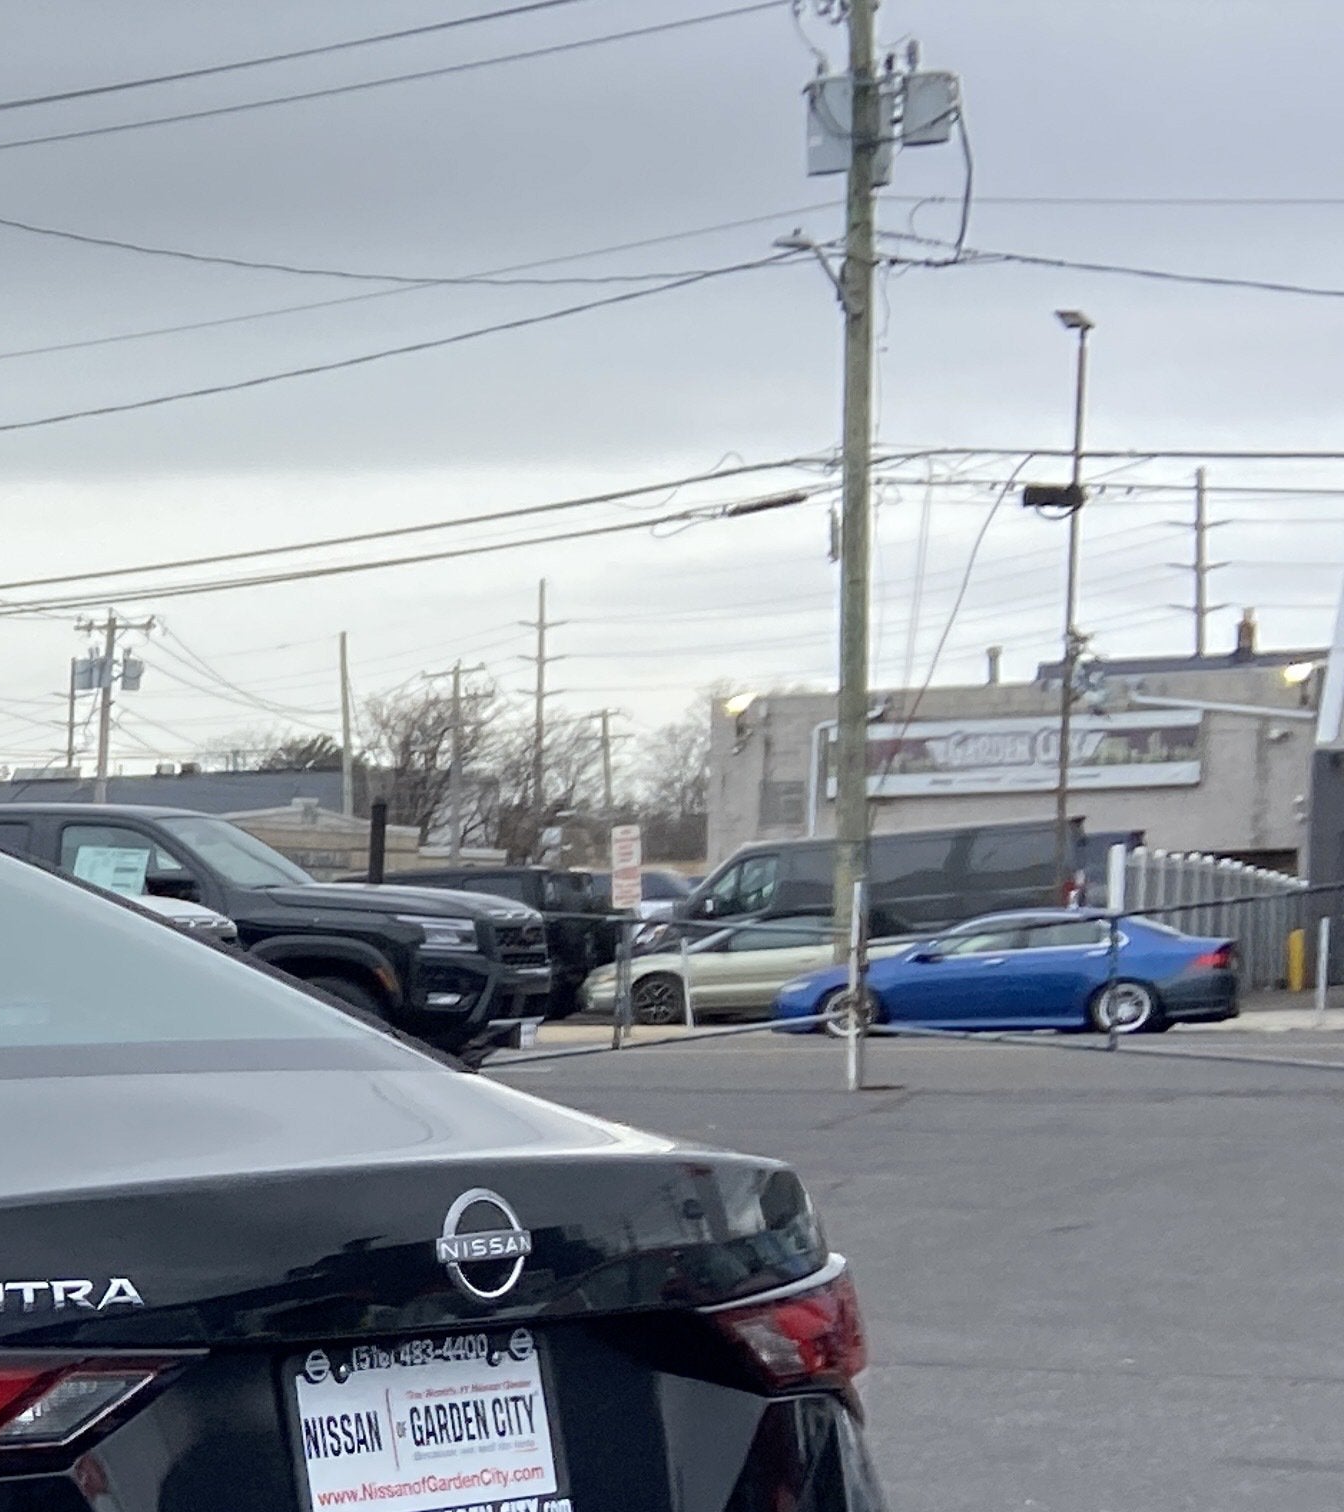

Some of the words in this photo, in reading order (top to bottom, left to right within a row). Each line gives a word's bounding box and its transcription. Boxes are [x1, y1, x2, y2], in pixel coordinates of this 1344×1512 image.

[440, 1236, 531, 1260] NISSAN
[400, 1333, 489, 1367] 483-4400
[303, 1410, 383, 1460] NISSAN
[409, 1400, 491, 1447] GARDEN
[492, 1393, 536, 1438] CITY
[317, 1465, 545, 1506] www.NissanofGardenCity.com
